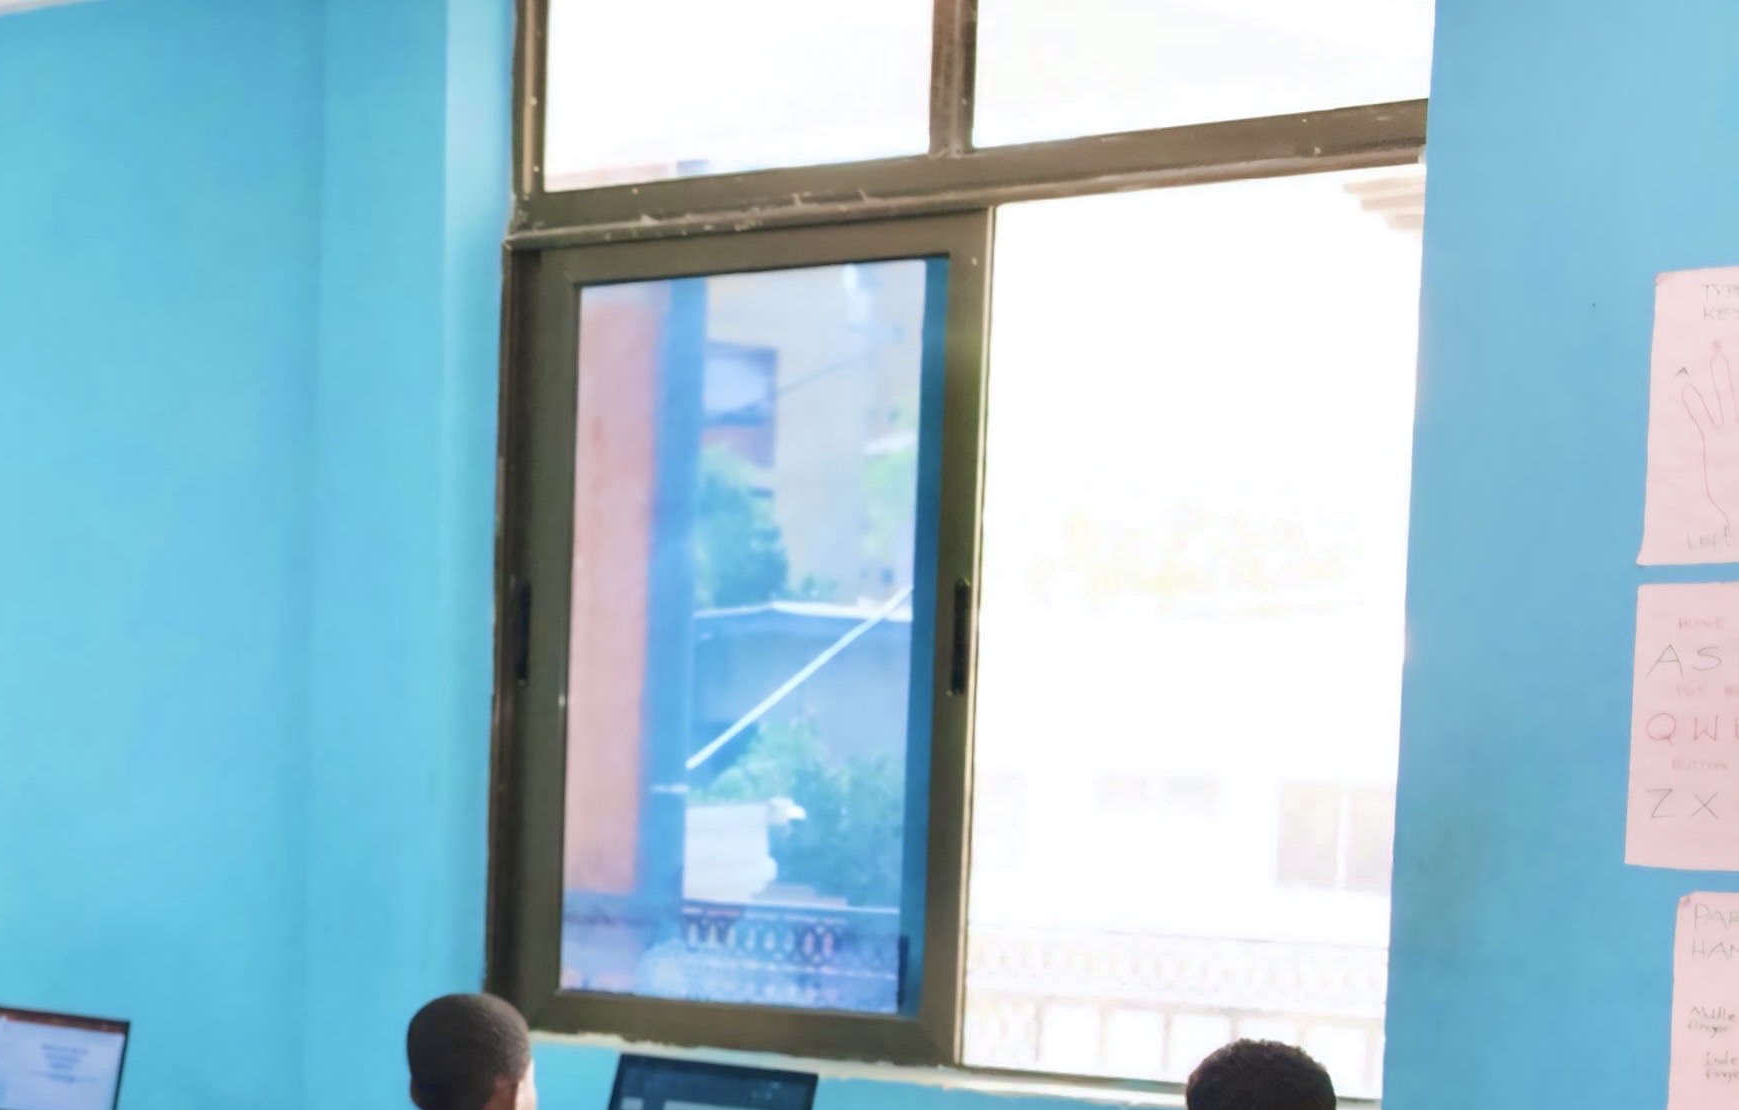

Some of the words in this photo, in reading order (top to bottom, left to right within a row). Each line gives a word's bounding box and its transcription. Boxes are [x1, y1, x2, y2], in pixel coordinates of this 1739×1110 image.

[1646, 643, 1684, 679] A
[1692, 645, 1723, 672] S
[1645, 712, 1677, 748] Q
[1692, 714, 1719, 741] W
[1645, 788, 1676, 819] Z
[1690, 791, 1720, 820] X
